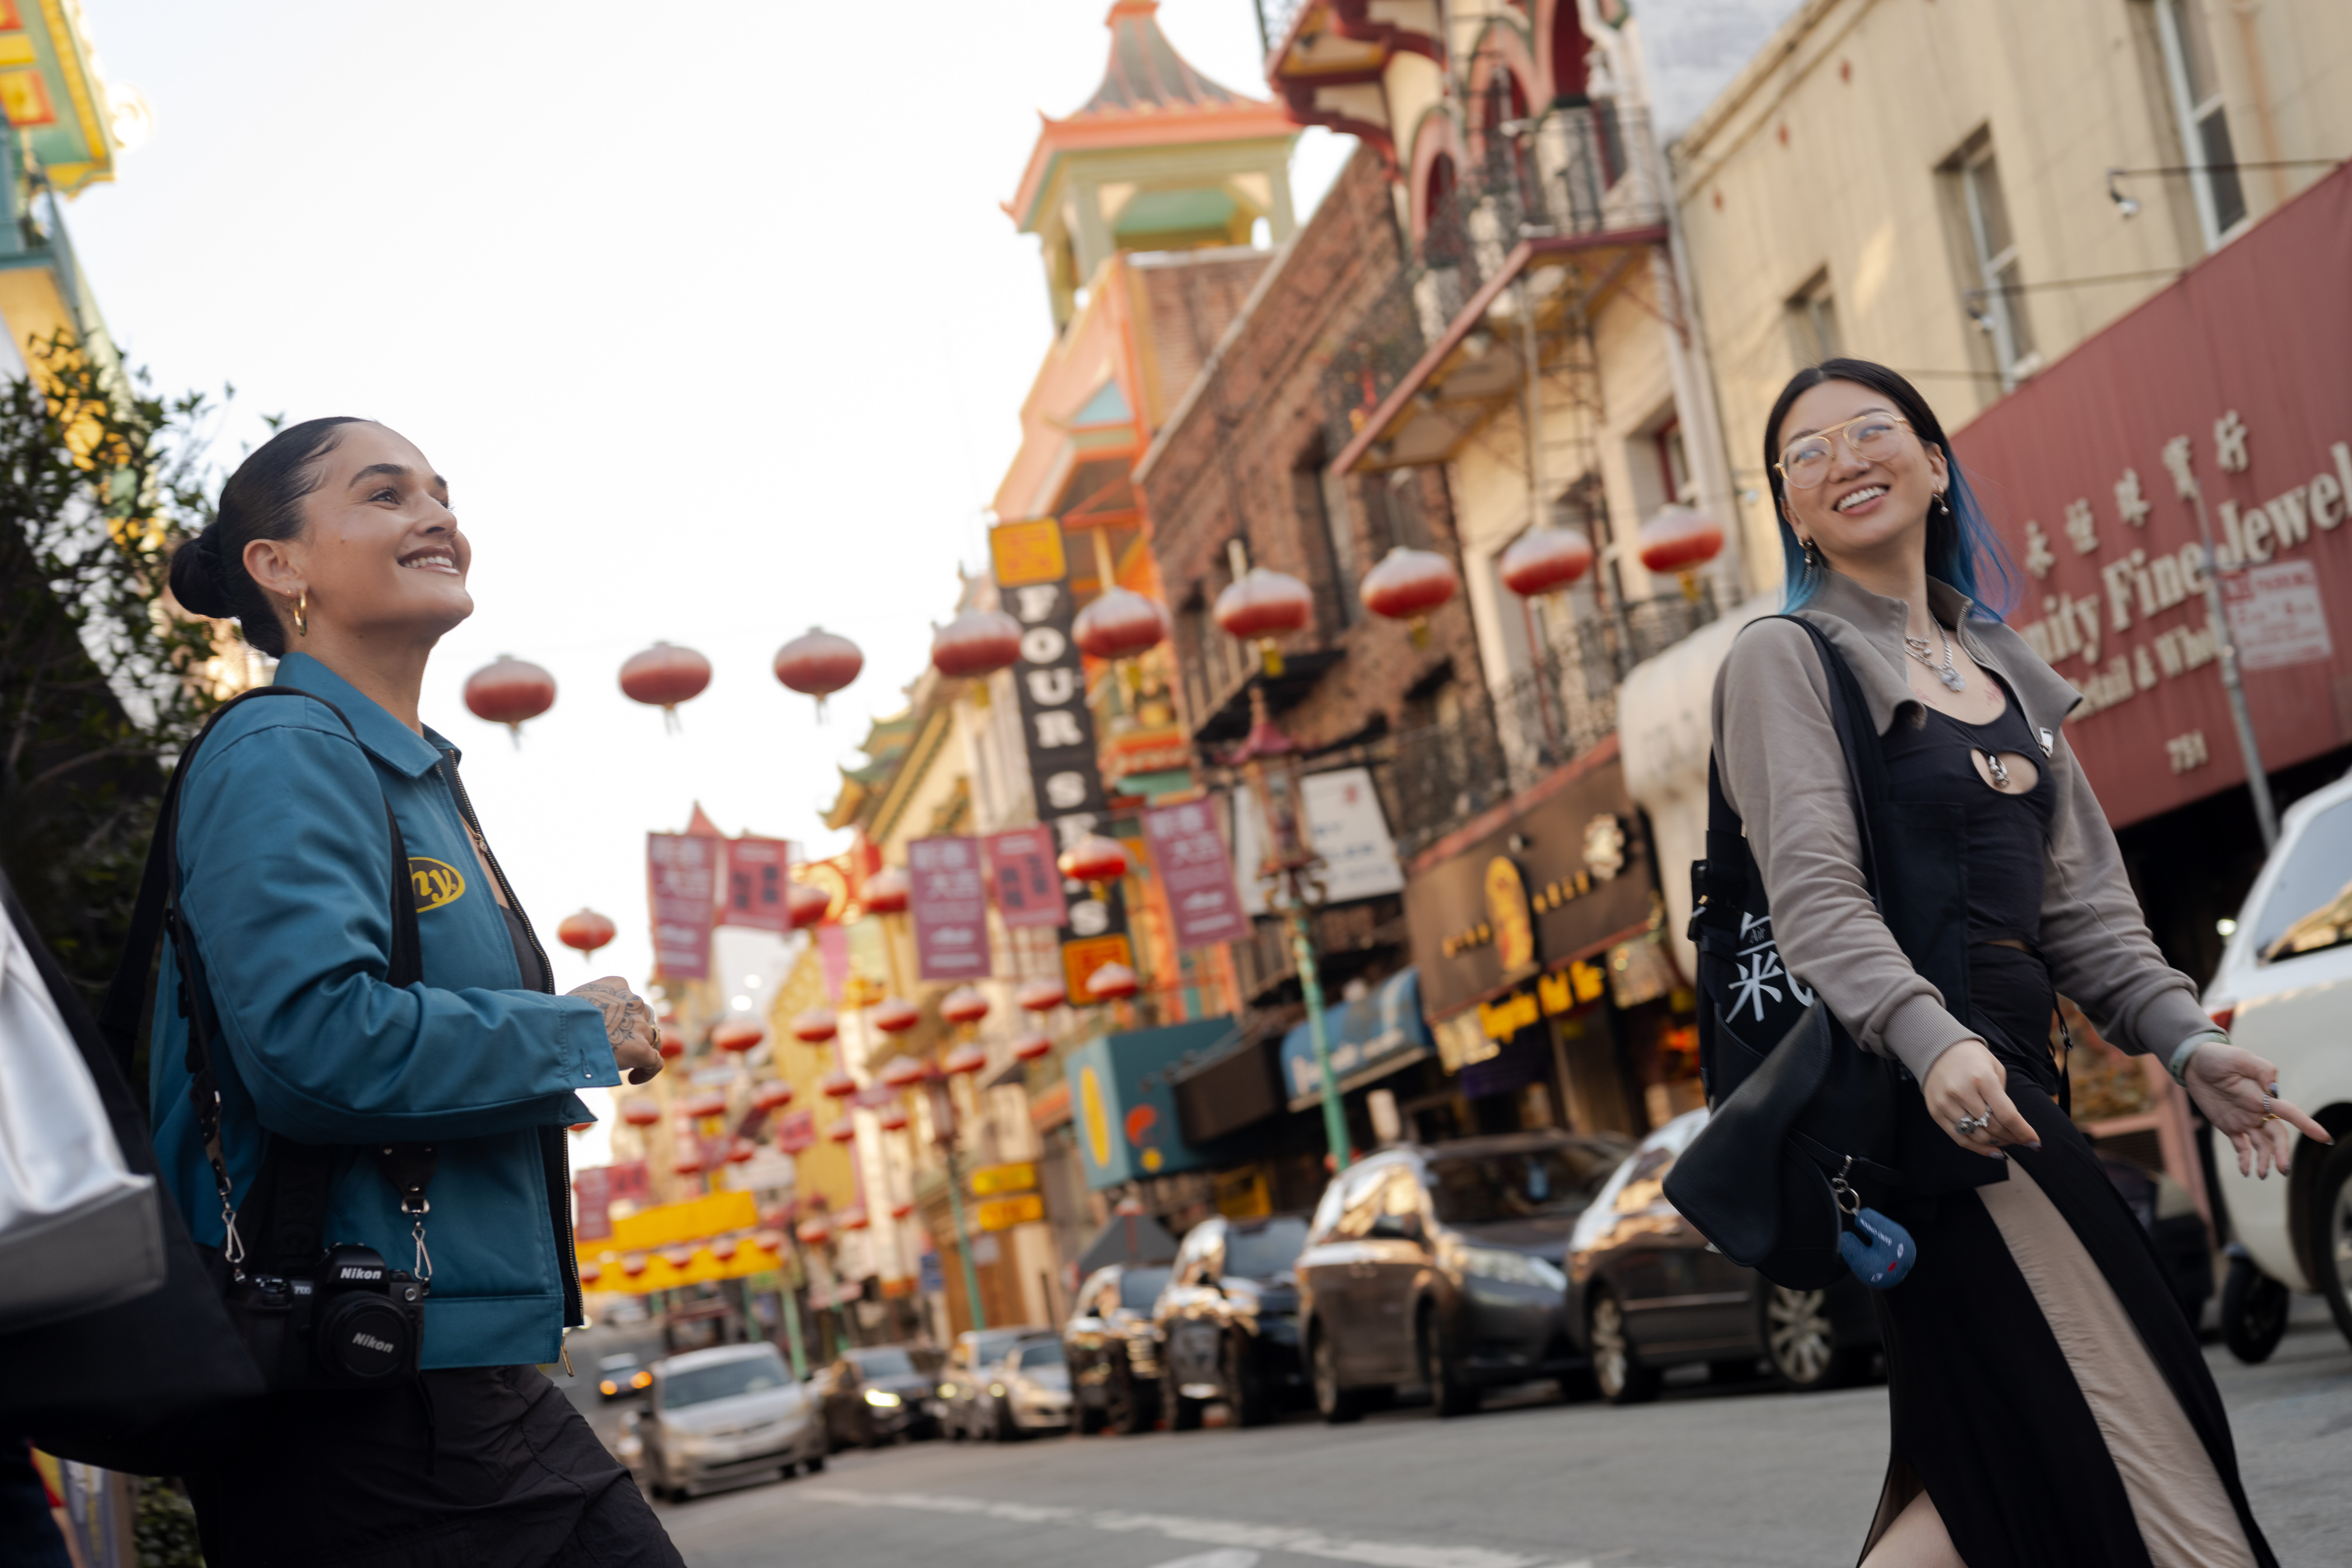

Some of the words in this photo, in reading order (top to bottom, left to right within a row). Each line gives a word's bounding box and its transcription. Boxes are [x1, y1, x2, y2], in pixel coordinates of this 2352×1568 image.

[2102, 542, 2205, 633] Fine
[1016, 584, 1085, 749] FOUR
[1046, 770, 1109, 937] SES
[340, 1267, 382, 1280] Nikon
[352, 1332, 394, 1354] Nikon
